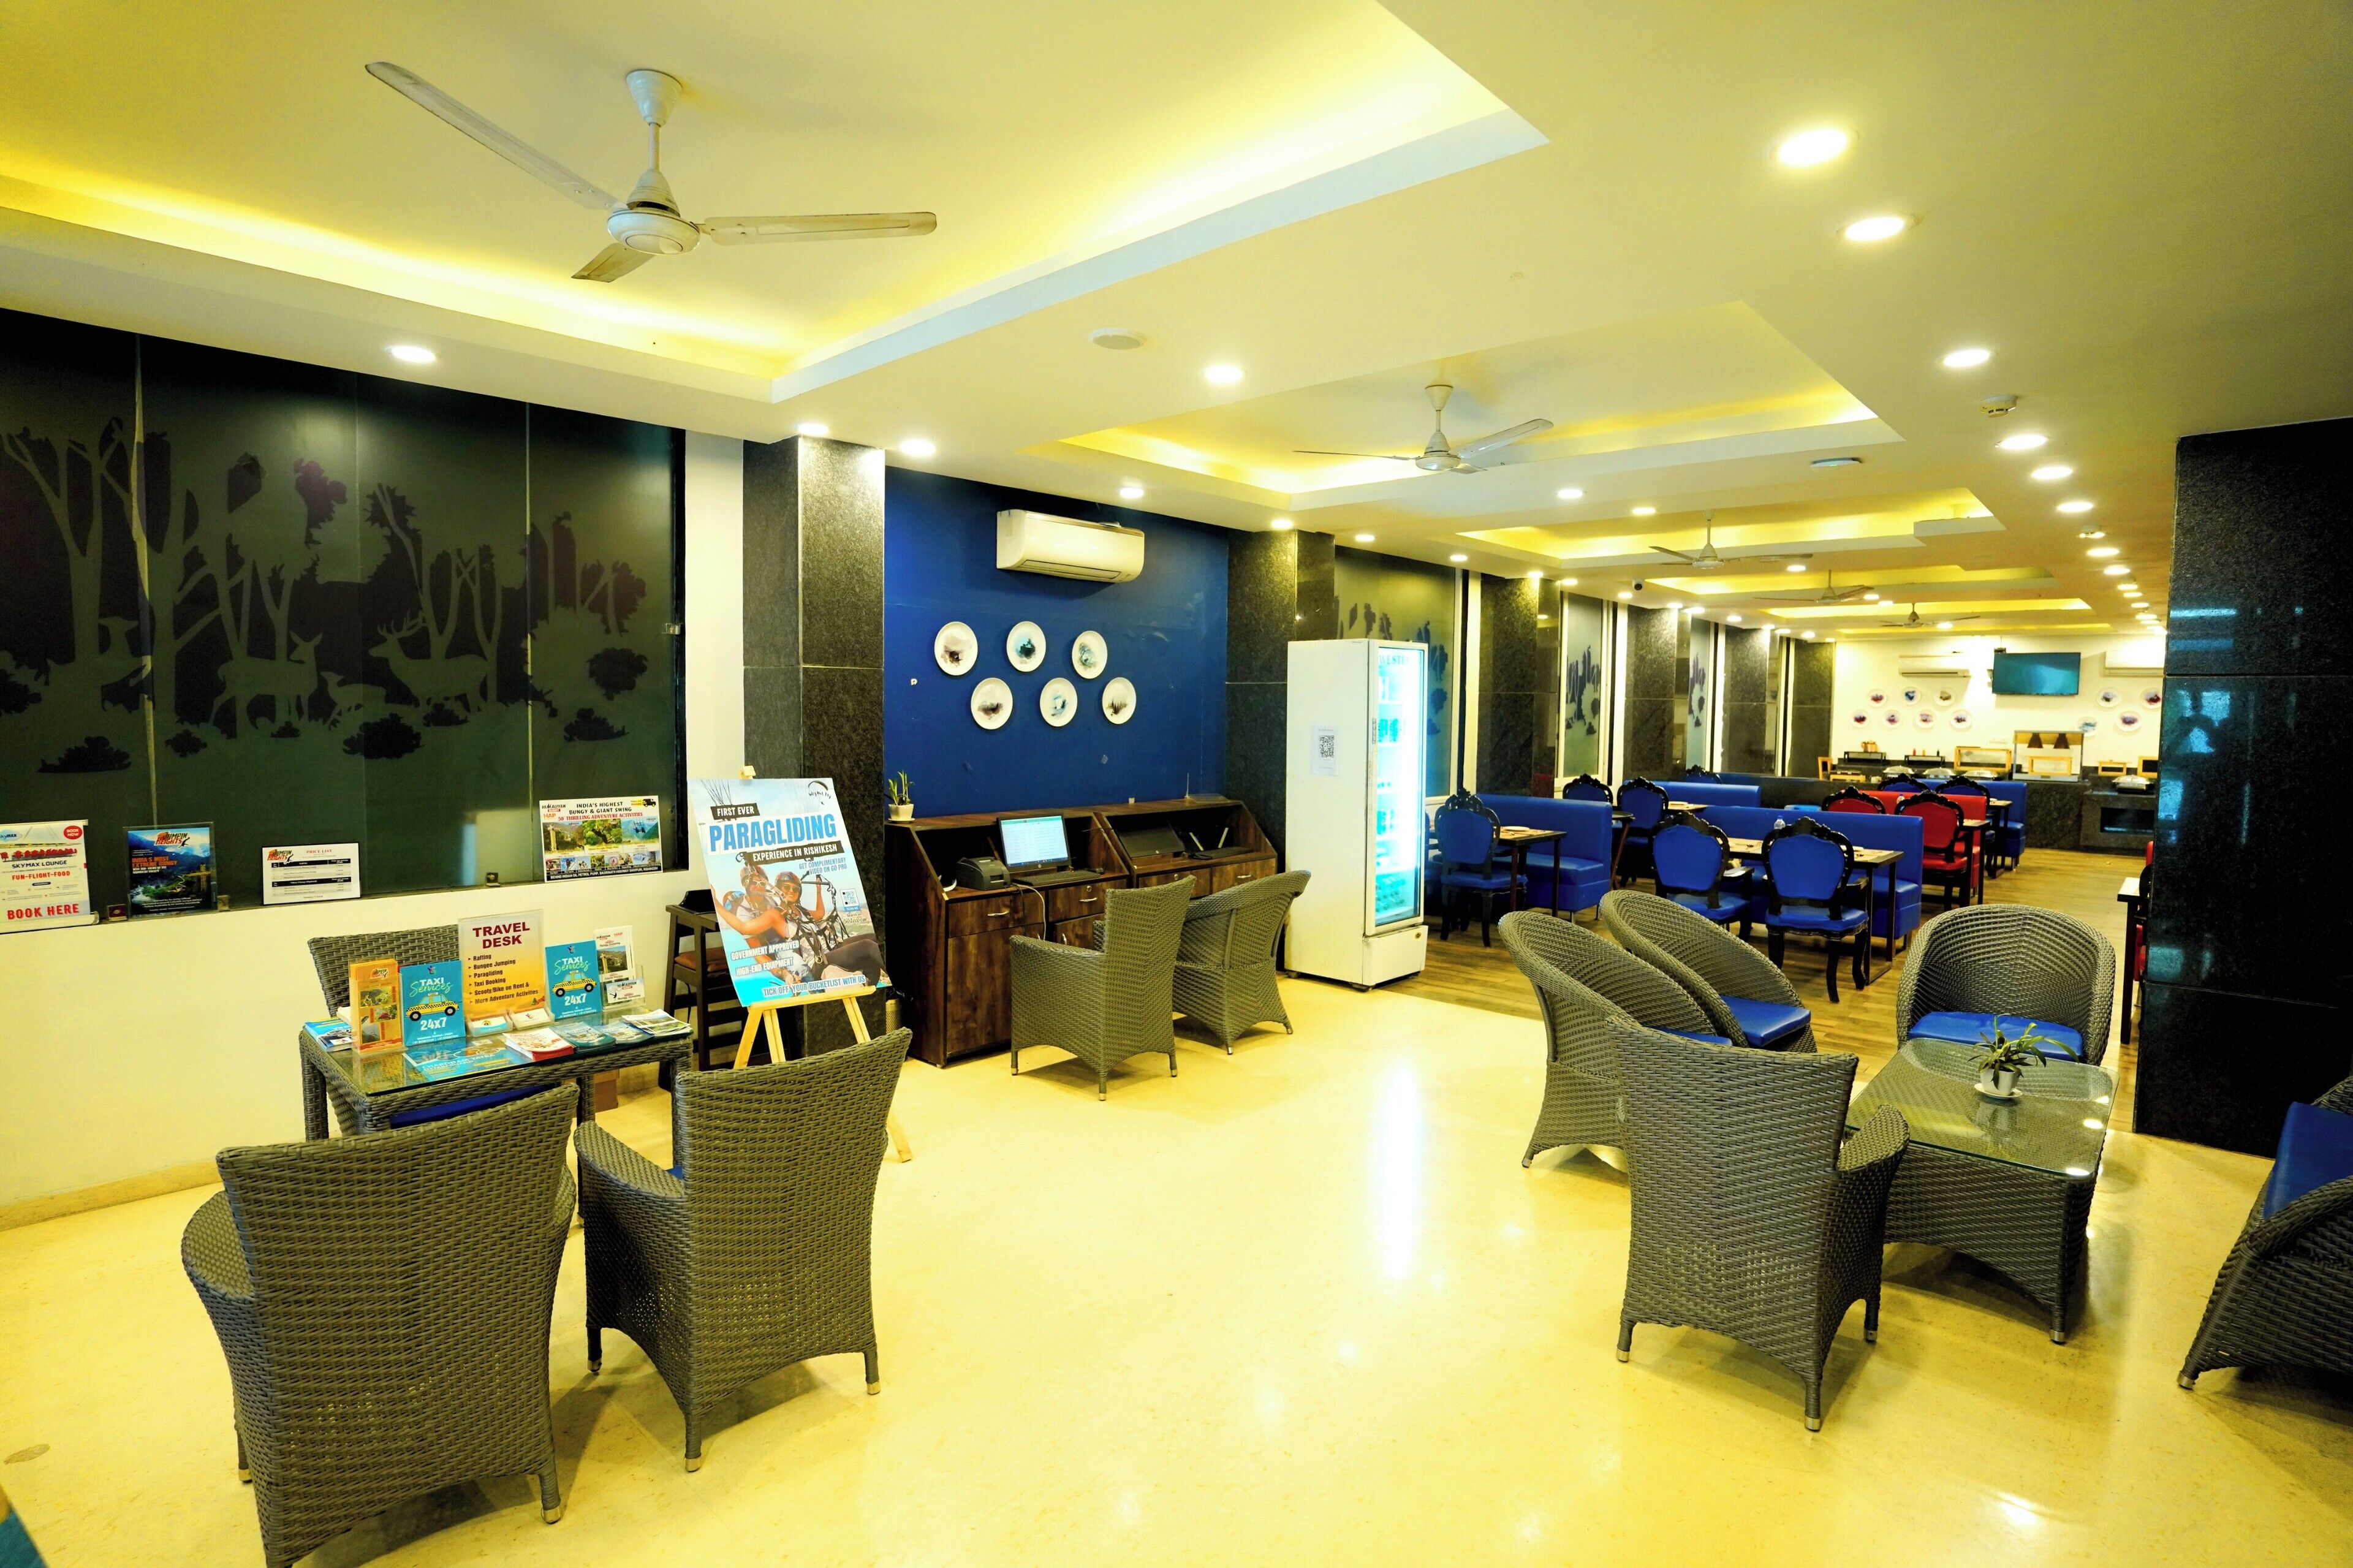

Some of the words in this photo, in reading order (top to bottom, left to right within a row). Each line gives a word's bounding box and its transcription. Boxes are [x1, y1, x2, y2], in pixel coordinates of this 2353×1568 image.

[717, 807, 735, 817] FIRST
[738, 806, 754, 815] EVER
[710, 813, 836, 852] PARAGLIDING
[752, 849, 793, 862] EXPERIENCE
[794, 848, 802, 857] IN
[803, 844, 838, 855] RISHIKESH
[808, 857, 846, 868] COMPLIMENTARY
[12, 871, 70, 881] FUN-FLIGHT-FOOD
[7, 907, 42, 920] BOOK
[47, 903, 79, 916] HERE
[472, 922, 530, 937] TRAVEL
[482, 934, 522, 949] DESK
[562, 956, 583, 965] TAXI
[731, 947, 768, 961] GOVERNMENT
[474, 969, 503, 978] Paragliding
[554, 960, 591, 975] Services
[736, 963, 762, 976] HIGH-END
[763, 957, 794, 970] EQUIPMENT
[420, 977, 444, 987] TAXI
[763, 988, 777, 996] TICK
[792, 984, 808, 993] YOUR
[809, 979, 841, 990] BUCKETLIST
[843, 977, 857, 985] WITH
[409, 981, 453, 998] Services
[474, 987, 504, 996] Scooty/Bike
[490, 993, 515, 1002] Adventure
[564, 993, 586, 1006] 24x7
[420, 1017, 447, 1031] 24x7
